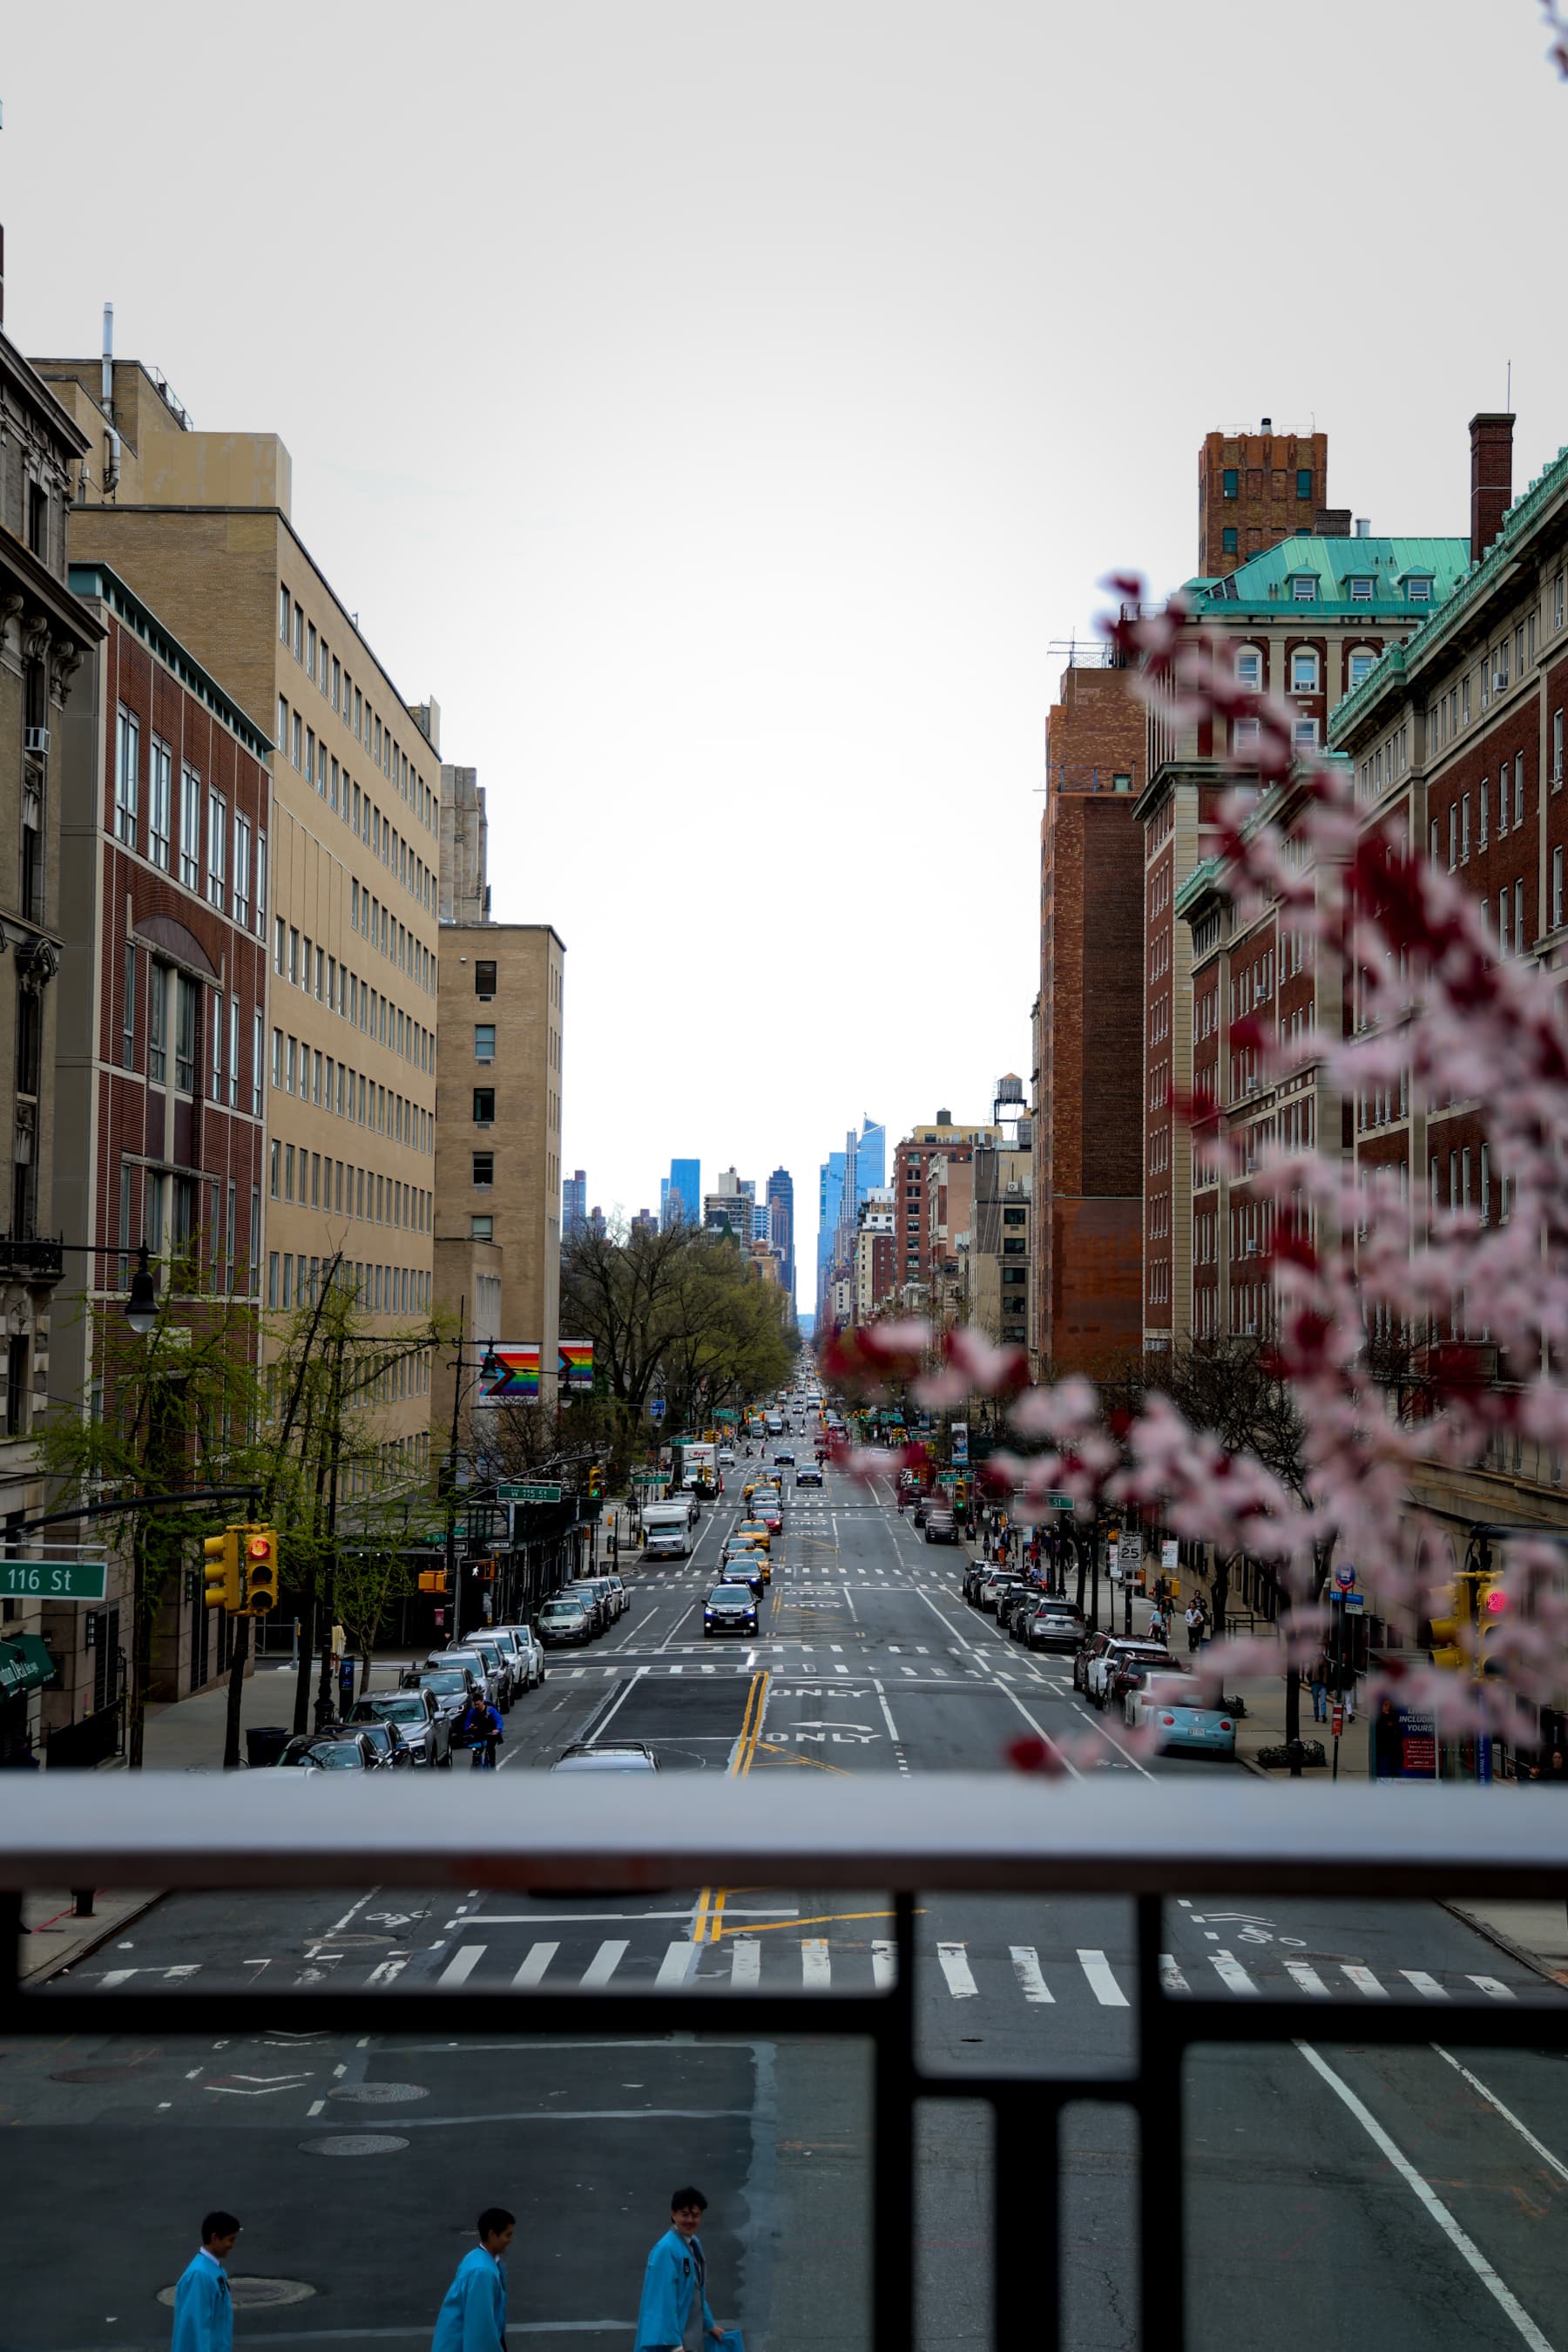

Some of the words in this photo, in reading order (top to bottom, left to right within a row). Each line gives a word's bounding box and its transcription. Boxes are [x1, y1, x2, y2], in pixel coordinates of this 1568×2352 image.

[510, 1488, 520, 1497] W
[523, 1489, 536, 1498] 115
[538, 1489, 547, 1499] St
[1053, 1497, 1061, 1506] St
[1121, 1548, 1139, 1559] 25
[8, 1568, 40, 1590] 116
[51, 1570, 72, 1591] St
[345, 1666, 351, 1675] P
[769, 1689, 872, 1698] ONLY
[764, 1733, 882, 1744] ONLY
